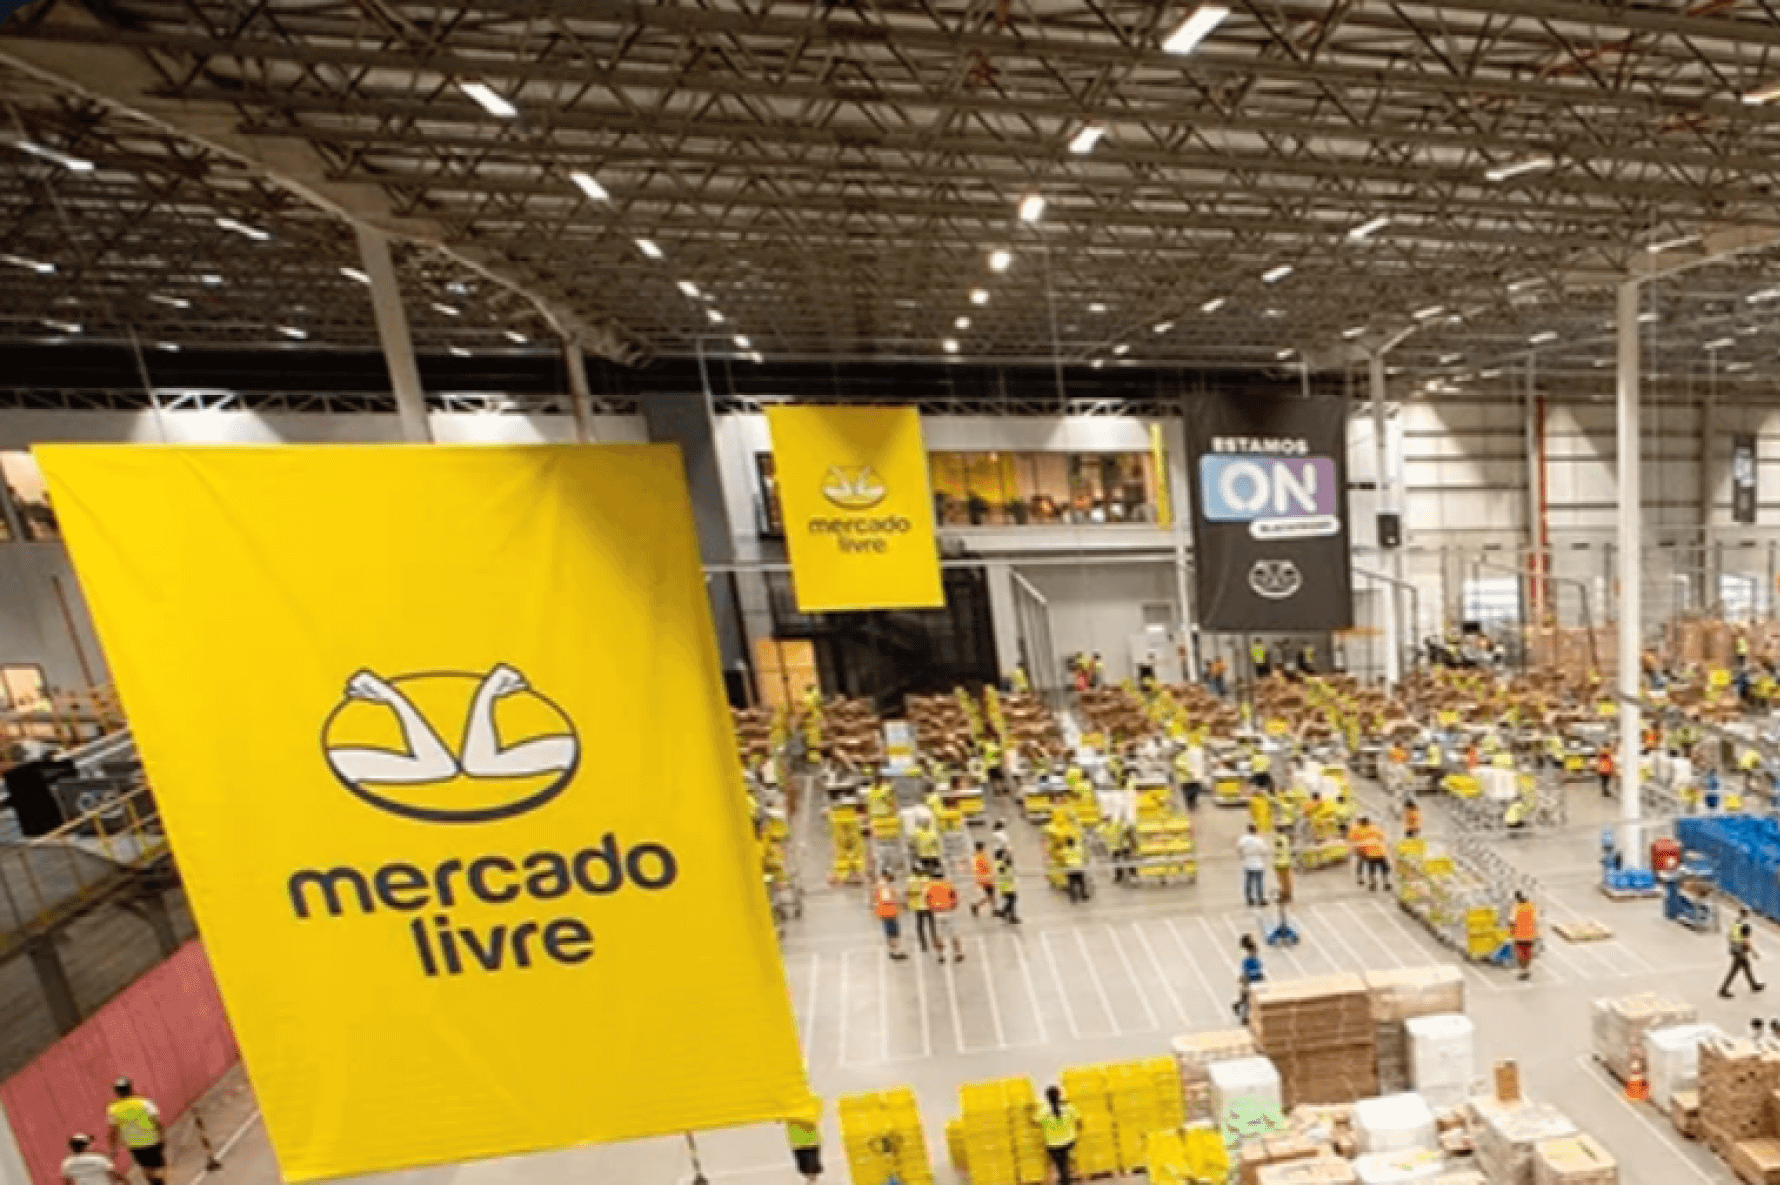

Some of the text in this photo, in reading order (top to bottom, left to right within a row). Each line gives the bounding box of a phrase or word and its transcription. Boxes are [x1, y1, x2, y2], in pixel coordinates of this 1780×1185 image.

[1220, 461, 1317, 514] ON
[287, 832, 677, 919] mercado
[410, 915, 593, 977] livre
